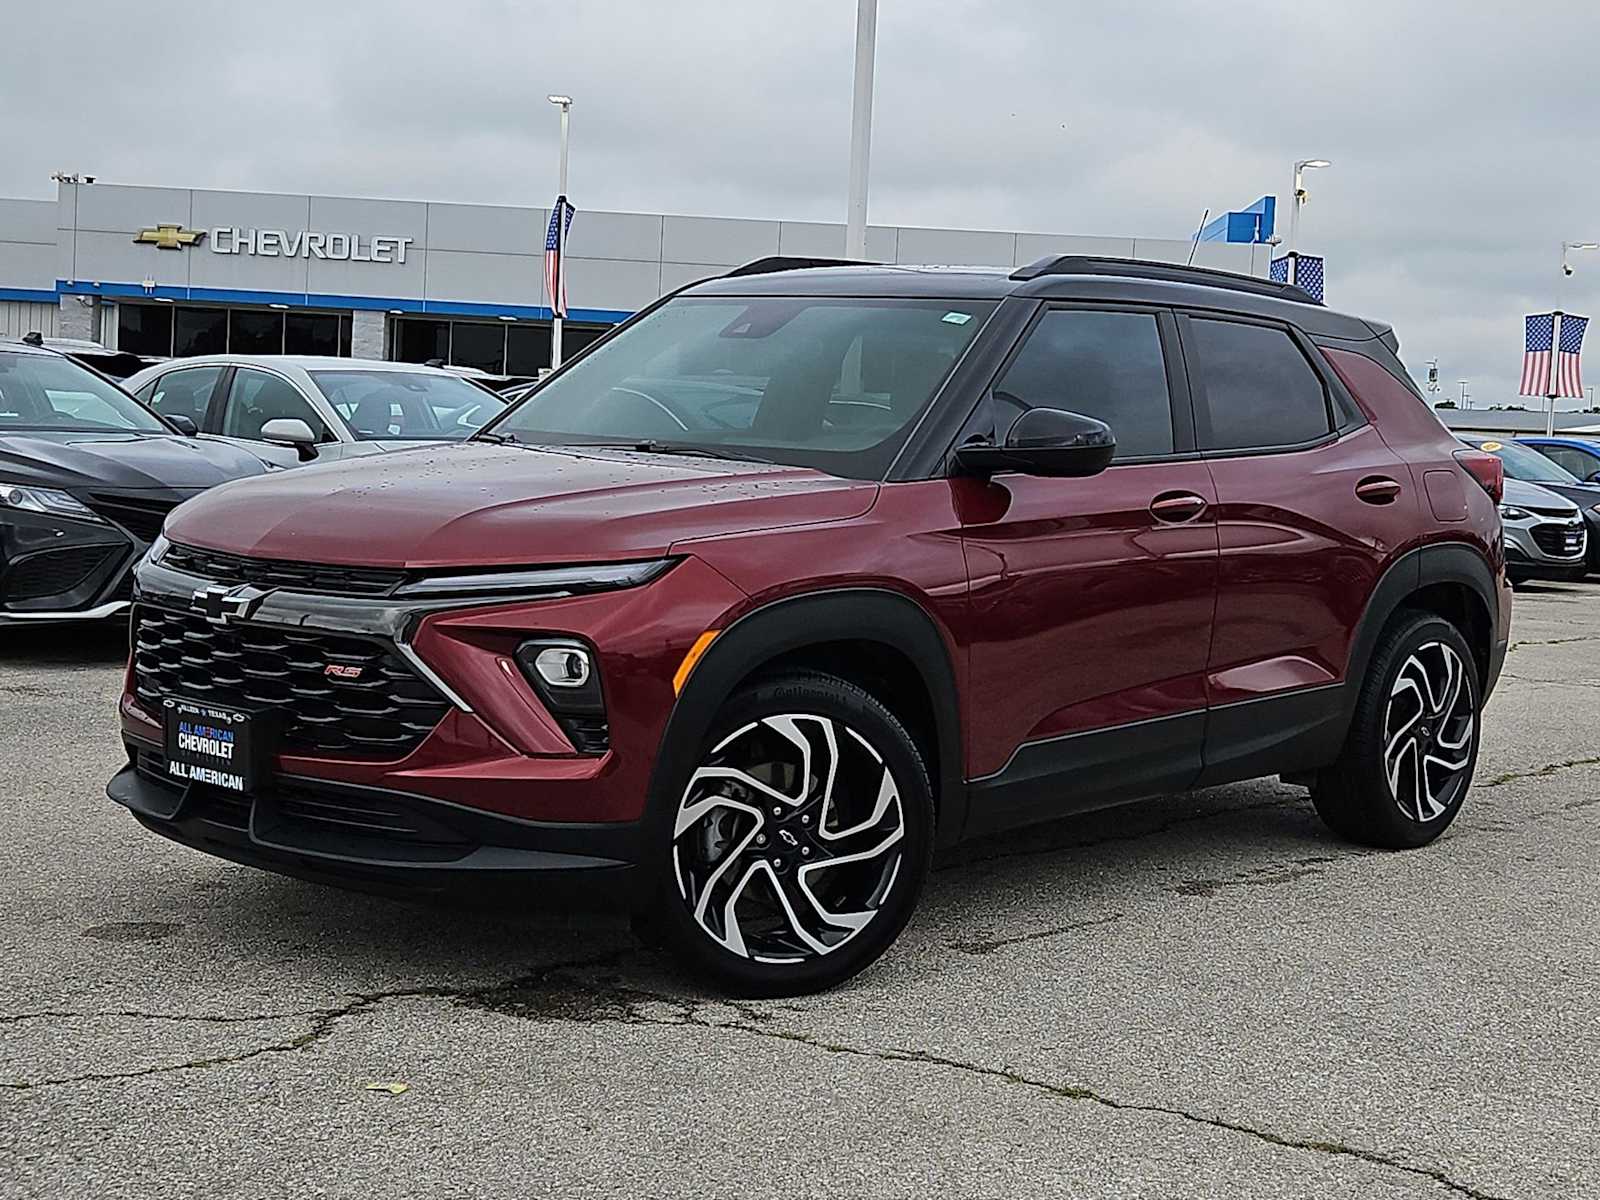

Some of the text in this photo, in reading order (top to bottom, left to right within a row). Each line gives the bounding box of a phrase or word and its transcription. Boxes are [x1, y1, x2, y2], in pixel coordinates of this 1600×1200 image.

[211, 227, 413, 262] CHEVROLET
[324, 664, 362, 678] RS
[208, 710, 227, 719] TEXAS
[179, 721, 234, 742] ALL AMERICAN
[178, 733, 234, 759] CHEVROLET
[169, 761, 243, 791] ALL AMERICAN
